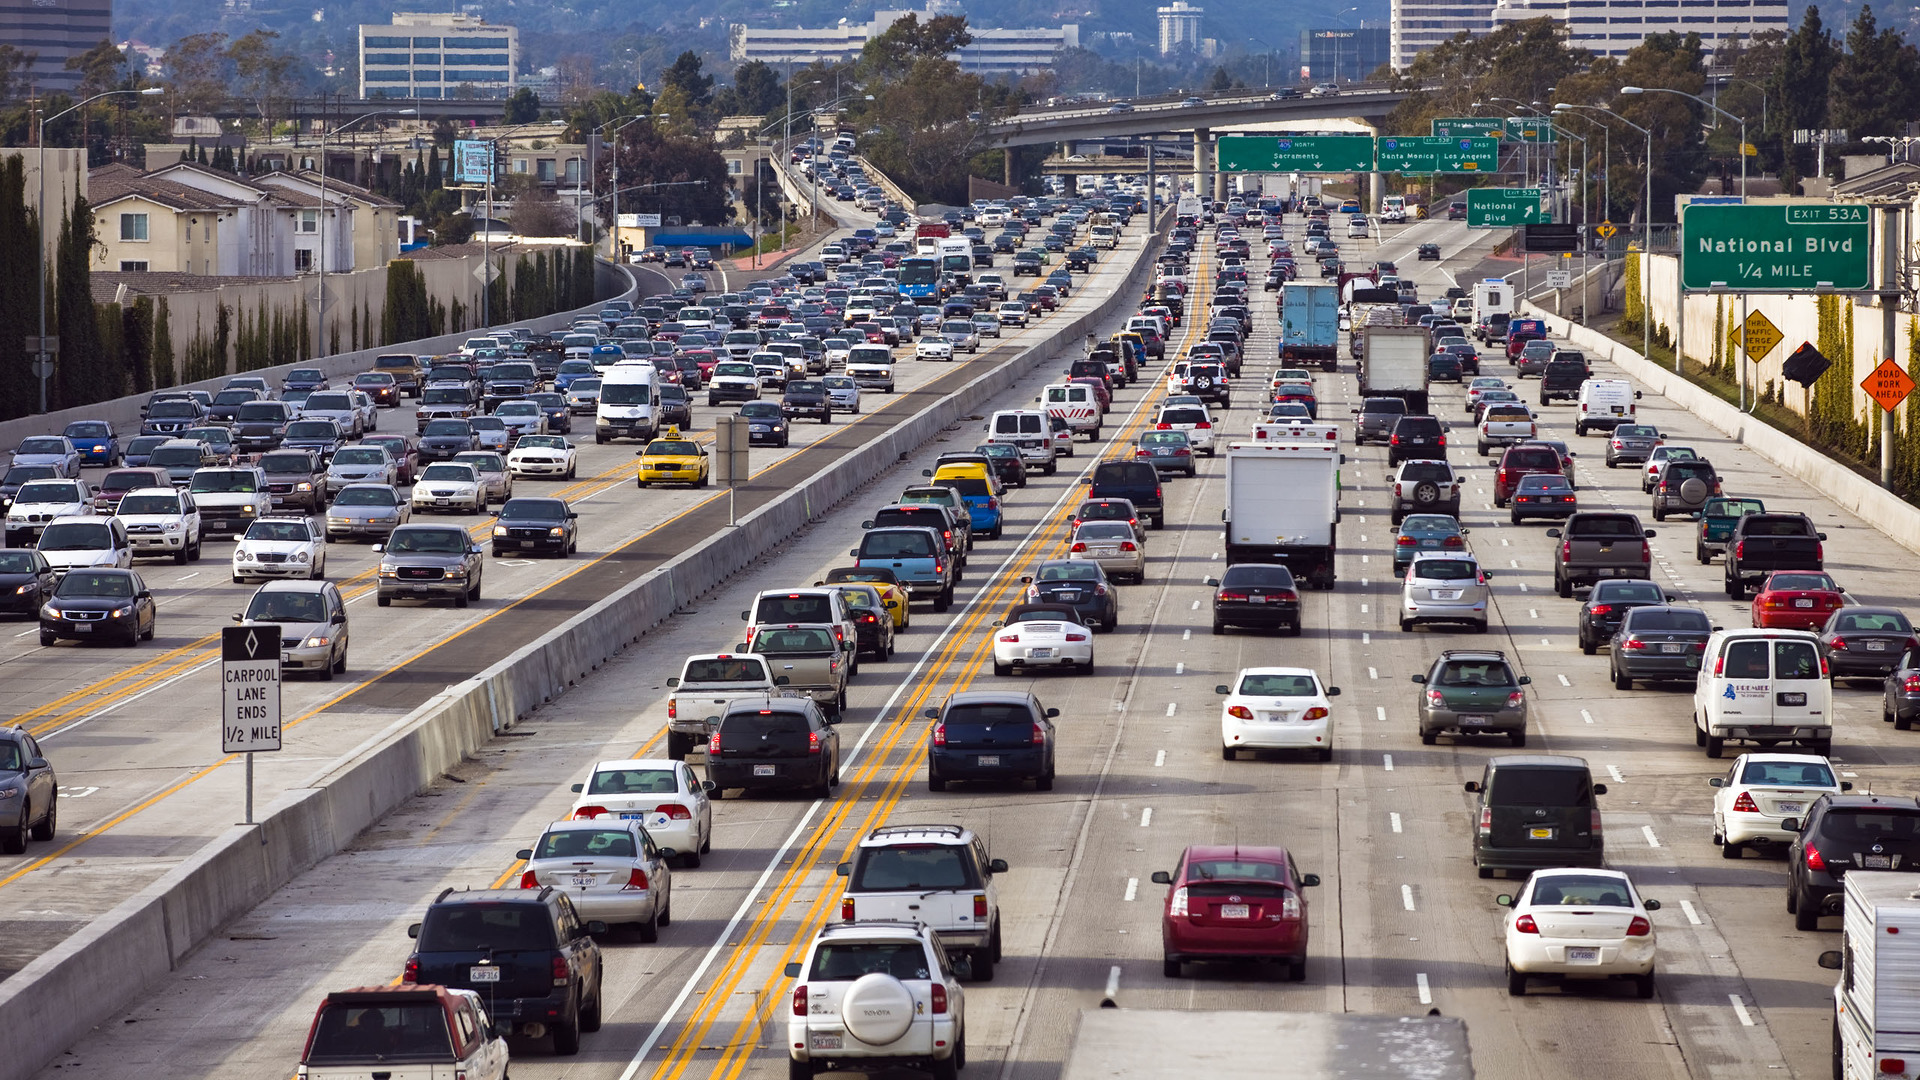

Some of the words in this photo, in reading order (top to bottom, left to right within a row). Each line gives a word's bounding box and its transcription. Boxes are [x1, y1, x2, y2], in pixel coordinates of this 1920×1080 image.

[1460, 153, 1492, 161] Angeles
[1473, 202, 1516, 210] National
[1484, 213, 1506, 221] Blvd
[1793, 209, 1821, 219] EXIT
[1828, 208, 1861, 220] 53A
[1699, 237, 1793, 253] National
[1805, 237, 1853, 253] Blvd
[1738, 262, 1763, 279] 1/4
[1771, 264, 1813, 277] MILE
[1747, 319, 1767, 327] THRU
[1746, 345, 1767, 353] LEFT
[1877, 369, 1900, 378] ROAD
[1877, 380, 1901, 389] WORK
[1875, 390, 1904, 399] AHEAD
[226, 668, 278, 683] CARPOOL
[237, 687, 266, 701] LANE
[237, 705, 267, 719] ENDS
[226, 726, 244, 743] 1/2
[251, 726, 278, 740] MILE
[471, 971, 498, 980] 6JHF316
